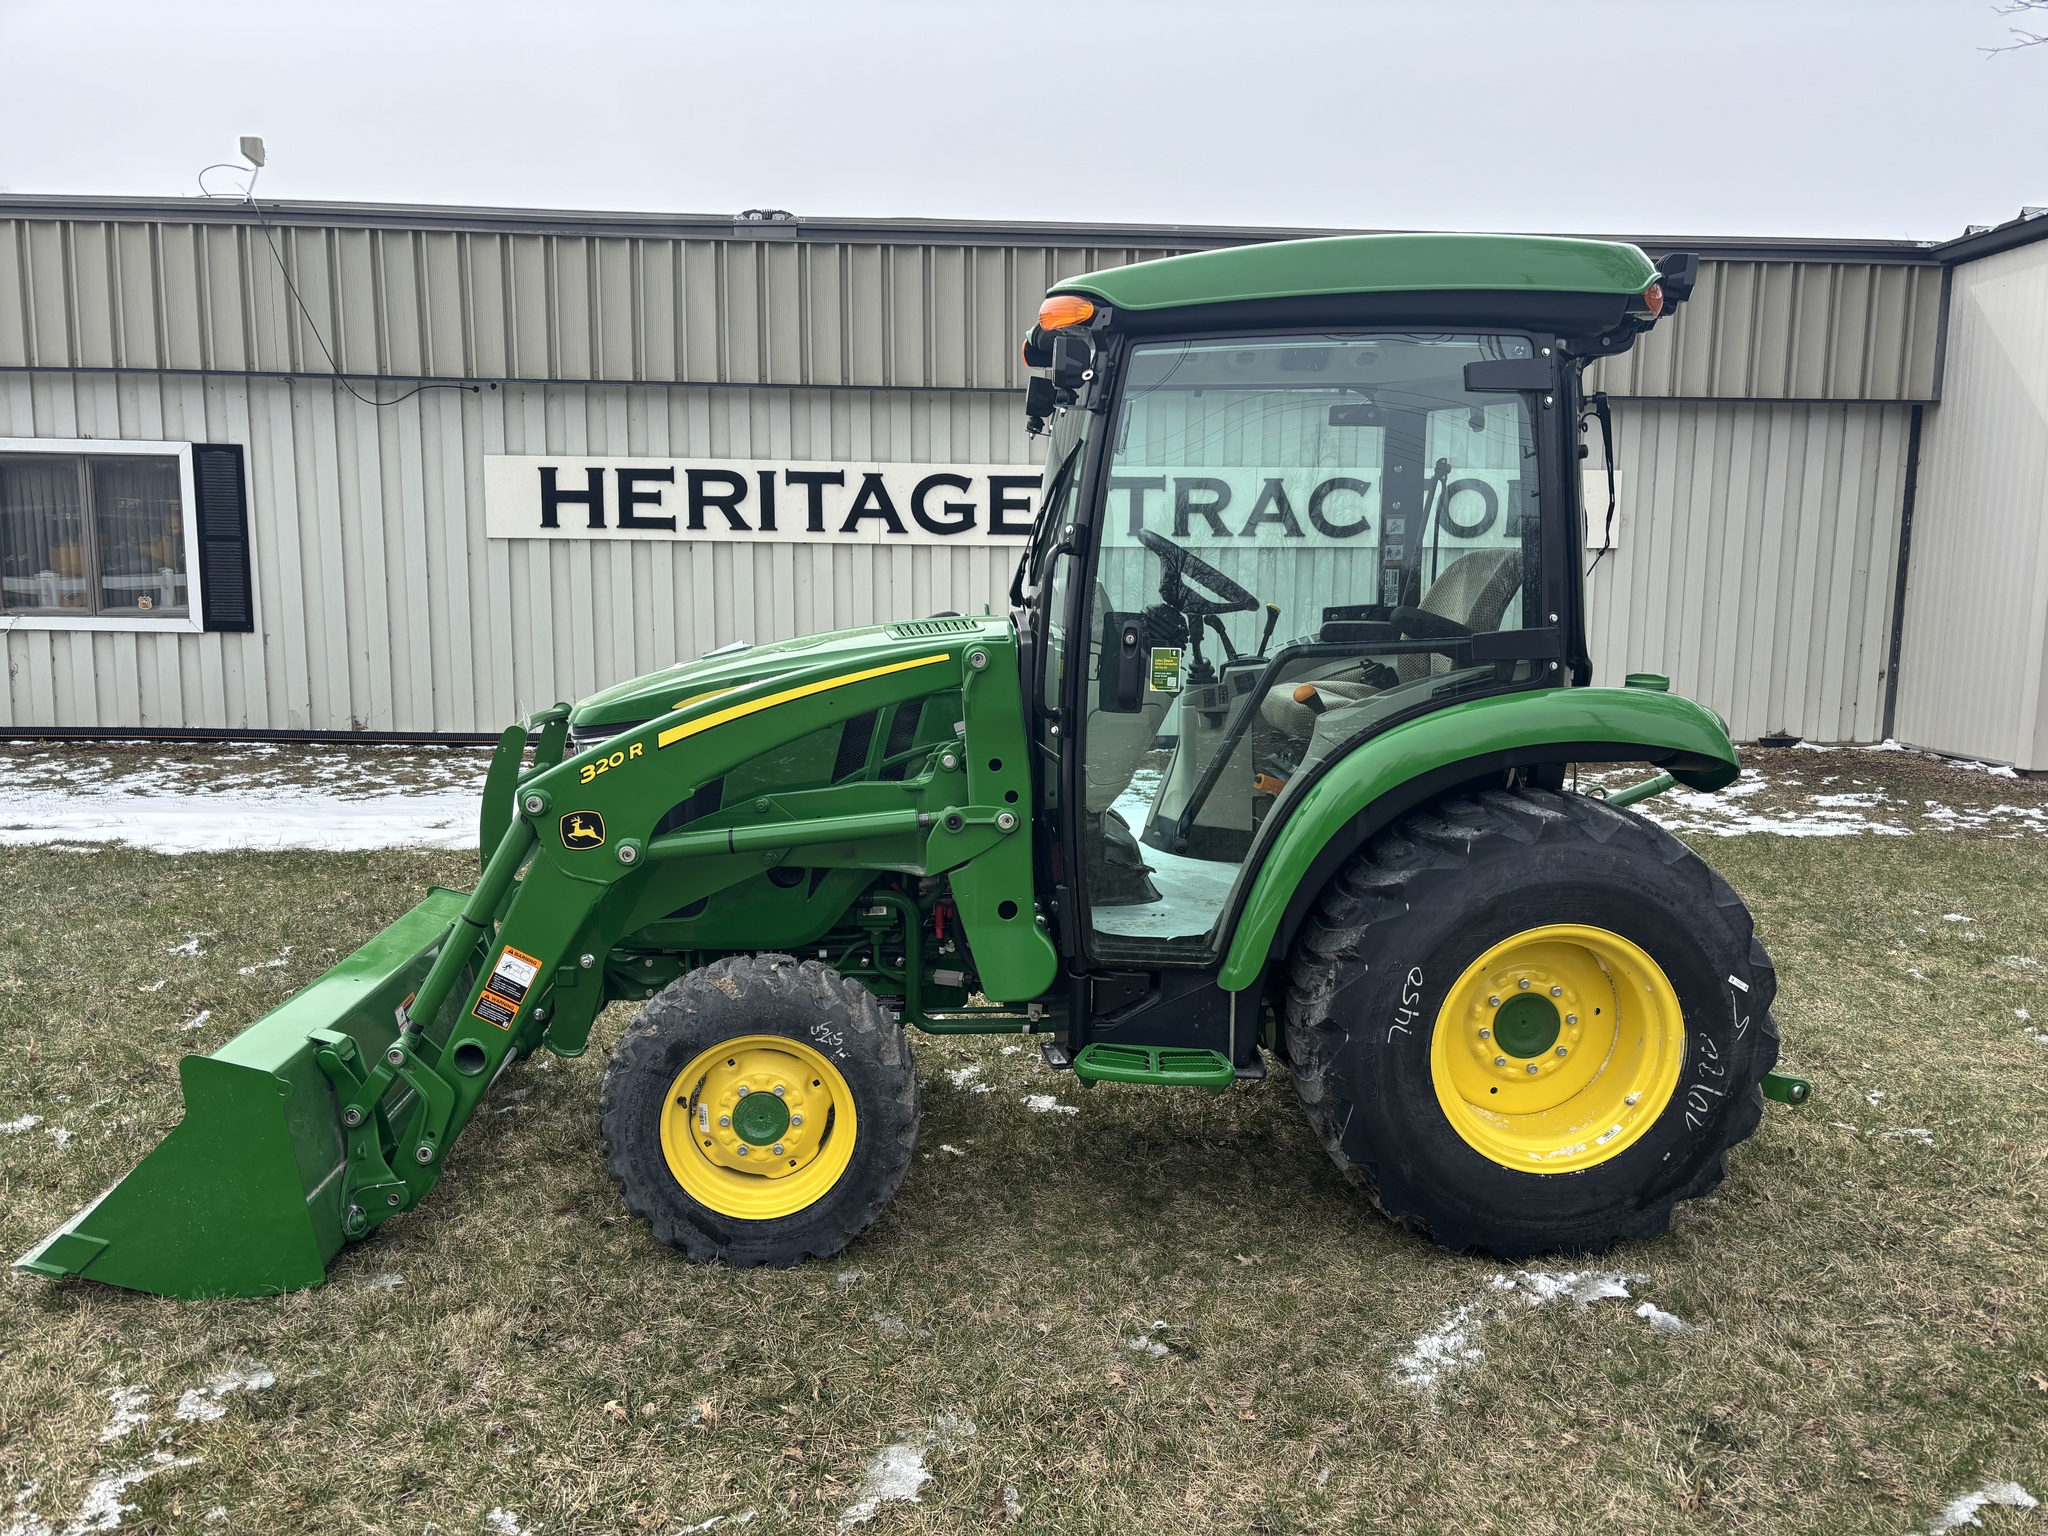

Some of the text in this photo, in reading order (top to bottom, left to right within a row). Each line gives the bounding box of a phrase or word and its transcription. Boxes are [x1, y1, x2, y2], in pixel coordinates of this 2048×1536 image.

[538, 466, 1521, 539] HERITAGE TRACO
[580, 742, 643, 784] 320 R
[514, 951, 537, 966] WARNING
[492, 997, 515, 1011] WARNING
